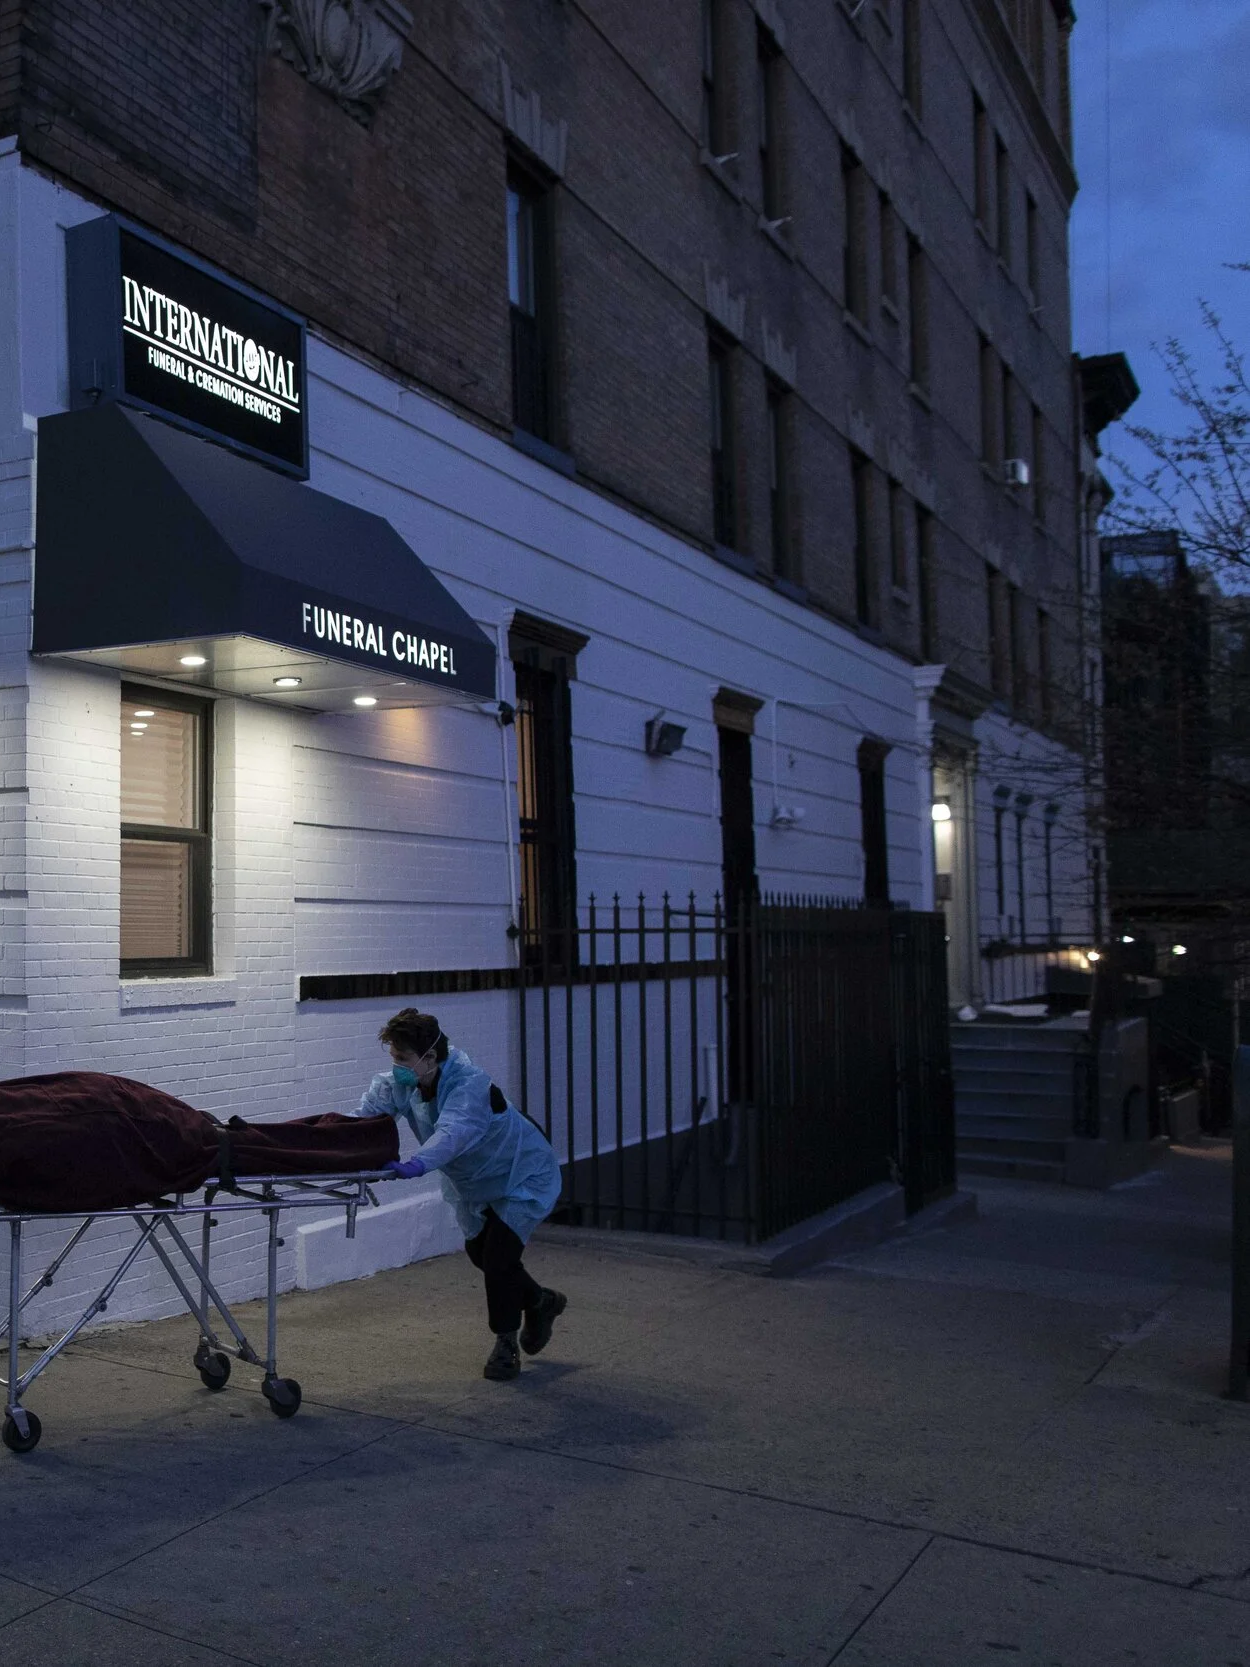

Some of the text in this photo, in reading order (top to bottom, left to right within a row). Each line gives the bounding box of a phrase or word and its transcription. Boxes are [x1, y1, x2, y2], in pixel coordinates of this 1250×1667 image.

[122, 275, 299, 404] INTERNATIONAL
[147, 345, 283, 424] FUNERAL & CREMATION SERVICES
[302, 602, 458, 676] FUNERAL CHAPEL
